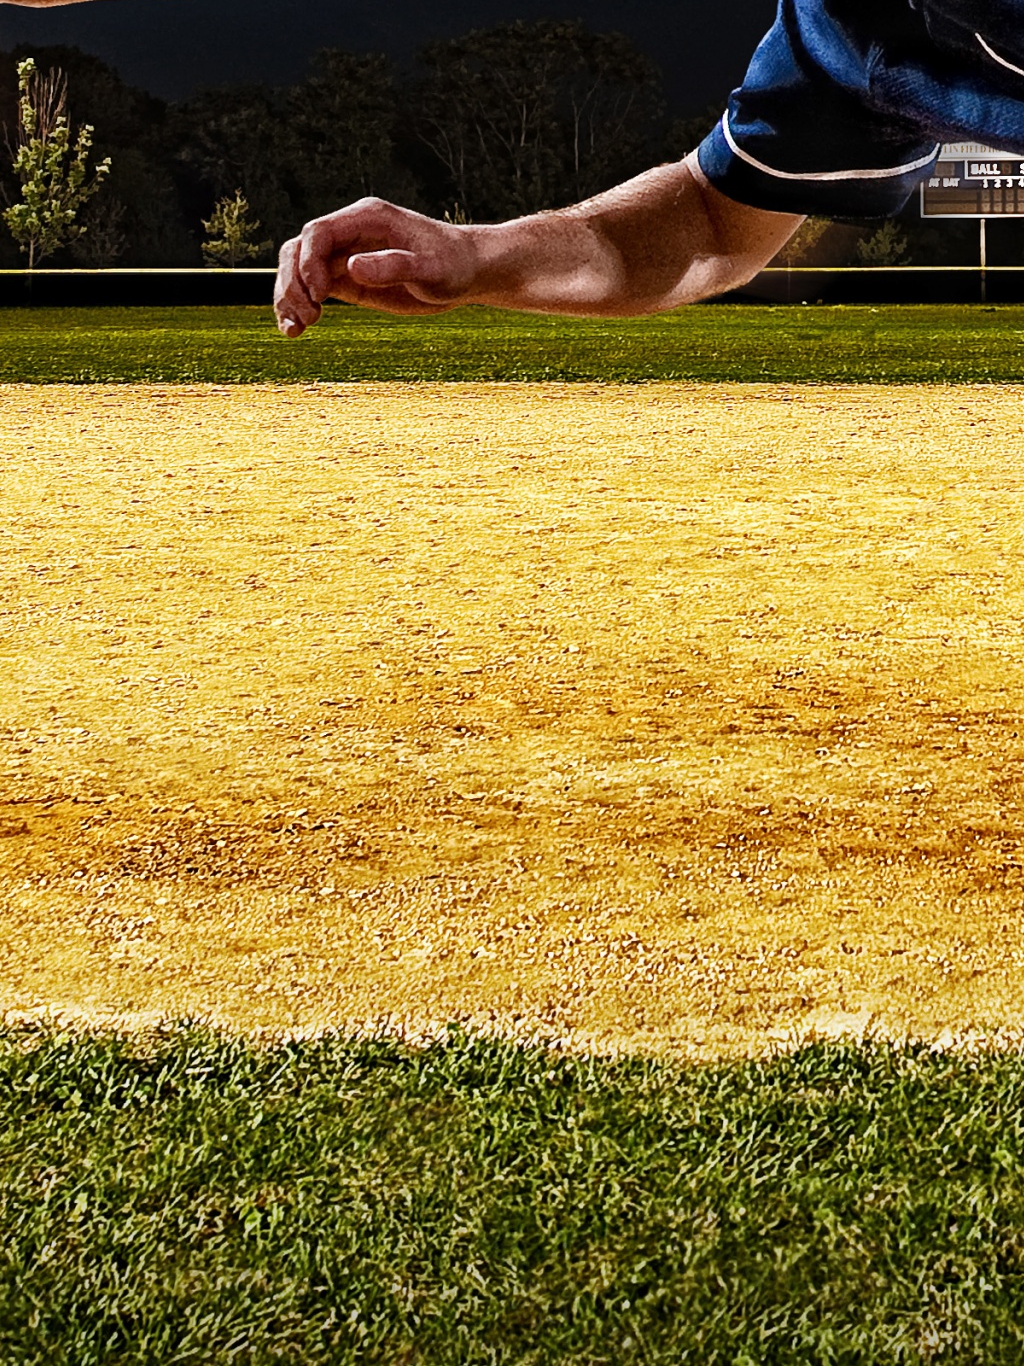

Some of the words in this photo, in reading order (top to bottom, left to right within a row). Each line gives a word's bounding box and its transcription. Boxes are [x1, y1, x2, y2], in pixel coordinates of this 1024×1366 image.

[971, 163, 1001, 174] BALL
[983, 178, 988, 188] 1
[994, 178, 1001, 188] 2
[1006, 178, 1013, 188] 3
[1018, 178, 1024, 188] 4
